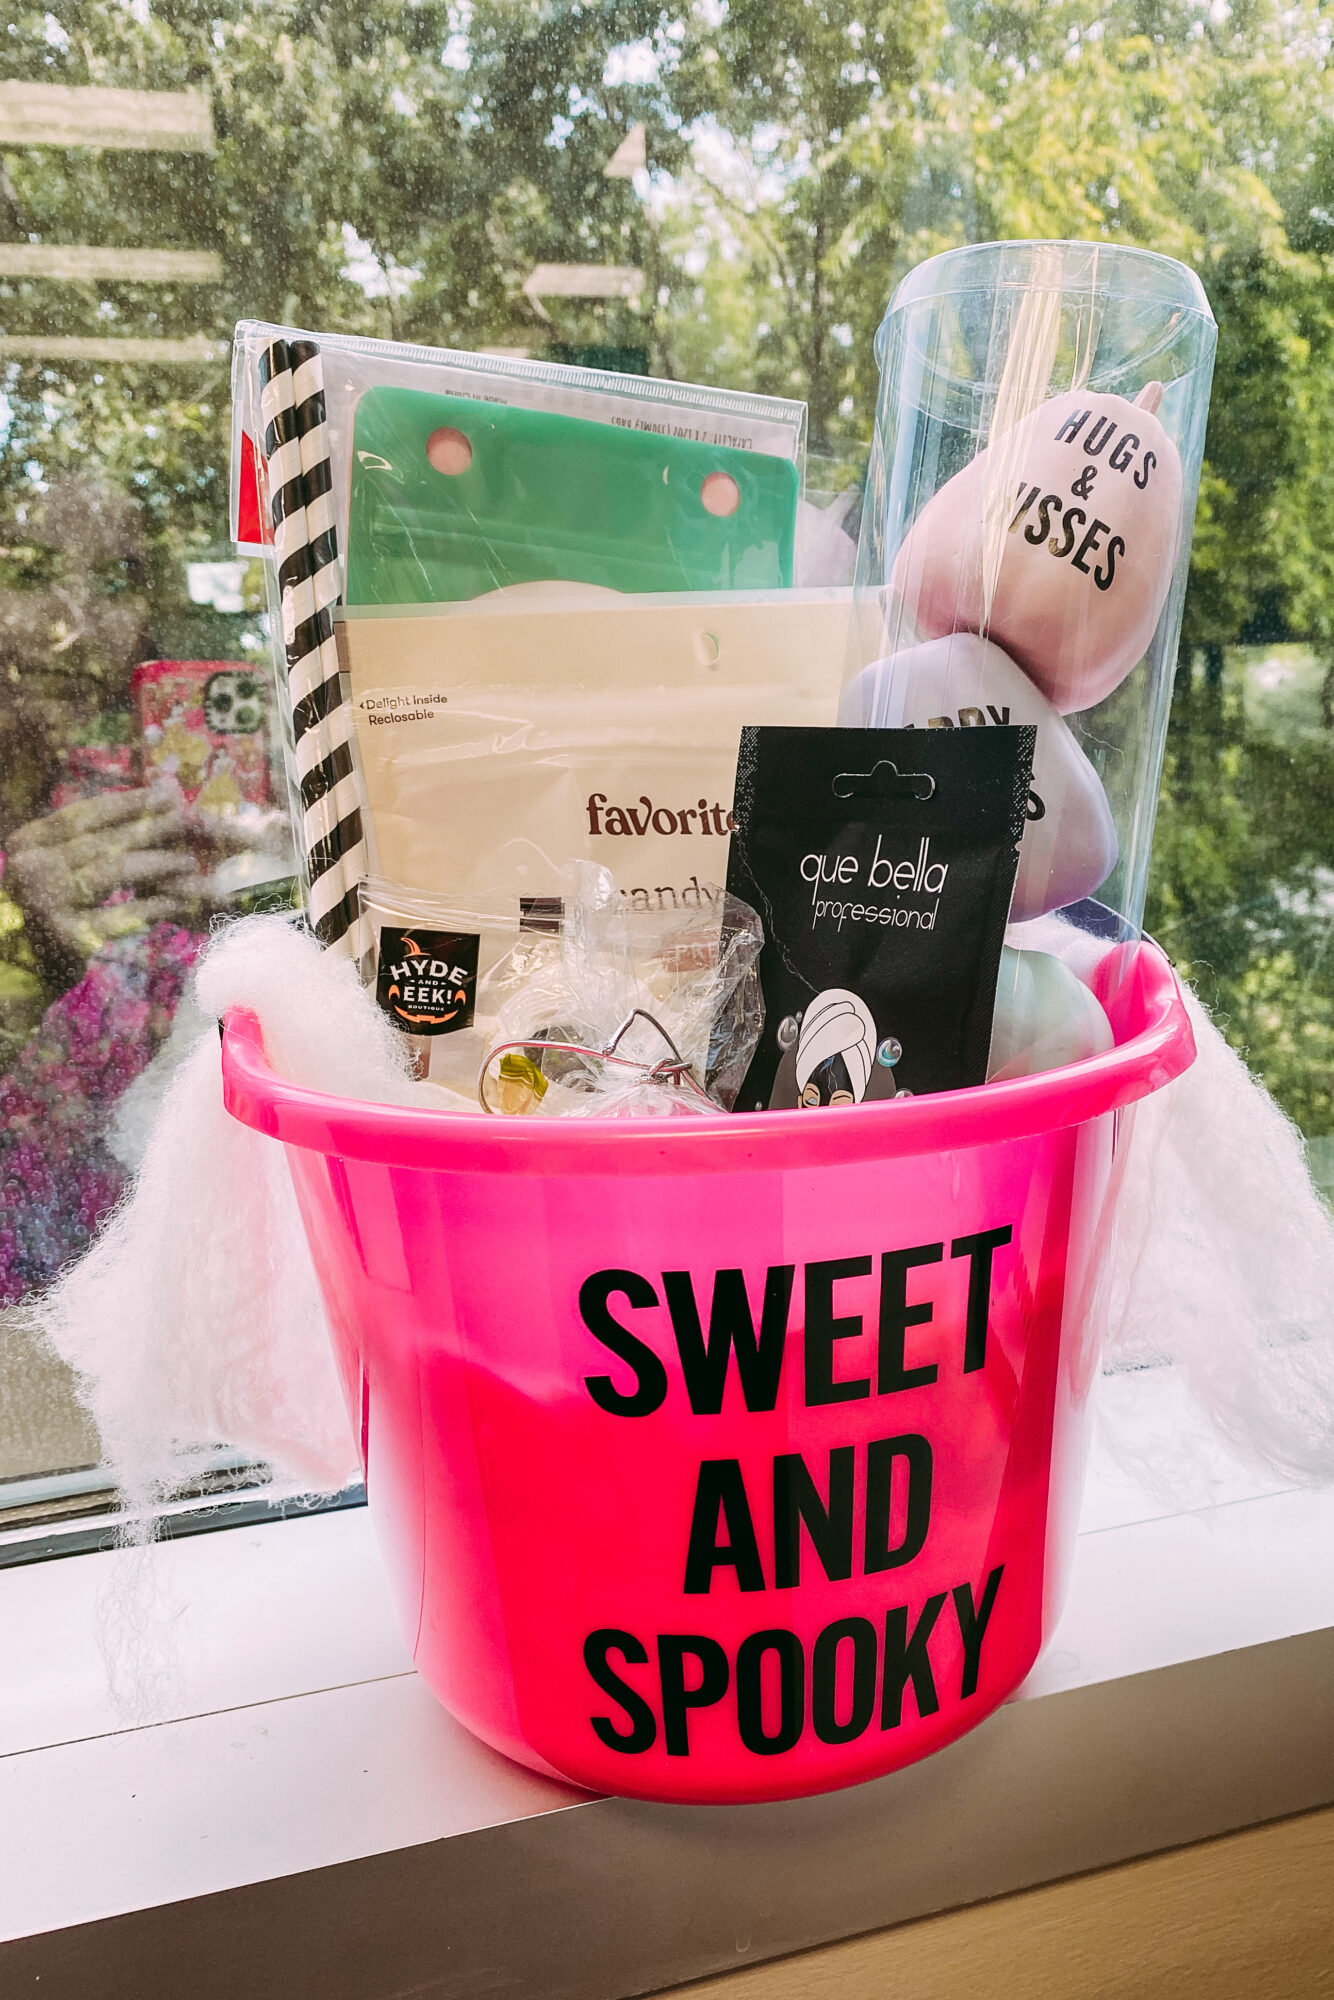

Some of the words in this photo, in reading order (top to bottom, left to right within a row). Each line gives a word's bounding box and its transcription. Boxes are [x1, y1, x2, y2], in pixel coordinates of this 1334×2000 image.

[1053, 408, 1157, 490] HUGS
[1071, 464, 1098, 501] &
[366, 696, 411, 710] Delight
[413, 693, 448, 706] Inside
[368, 709, 435, 726] Reclosable
[799, 853, 859, 906] que
[867, 834, 949, 894] bella
[617, 876, 724, 912] andy
[811, 894, 940, 933] professional
[389, 959, 469, 986] HYDE
[402, 985, 453, 1005] EEK!
[407, 1004, 446, 1012] BOUTIQUE
[578, 1223, 1013, 1418] SWEET
[682, 1433, 933, 1595] AND
[582, 1563, 1006, 1757] SPOOKY
